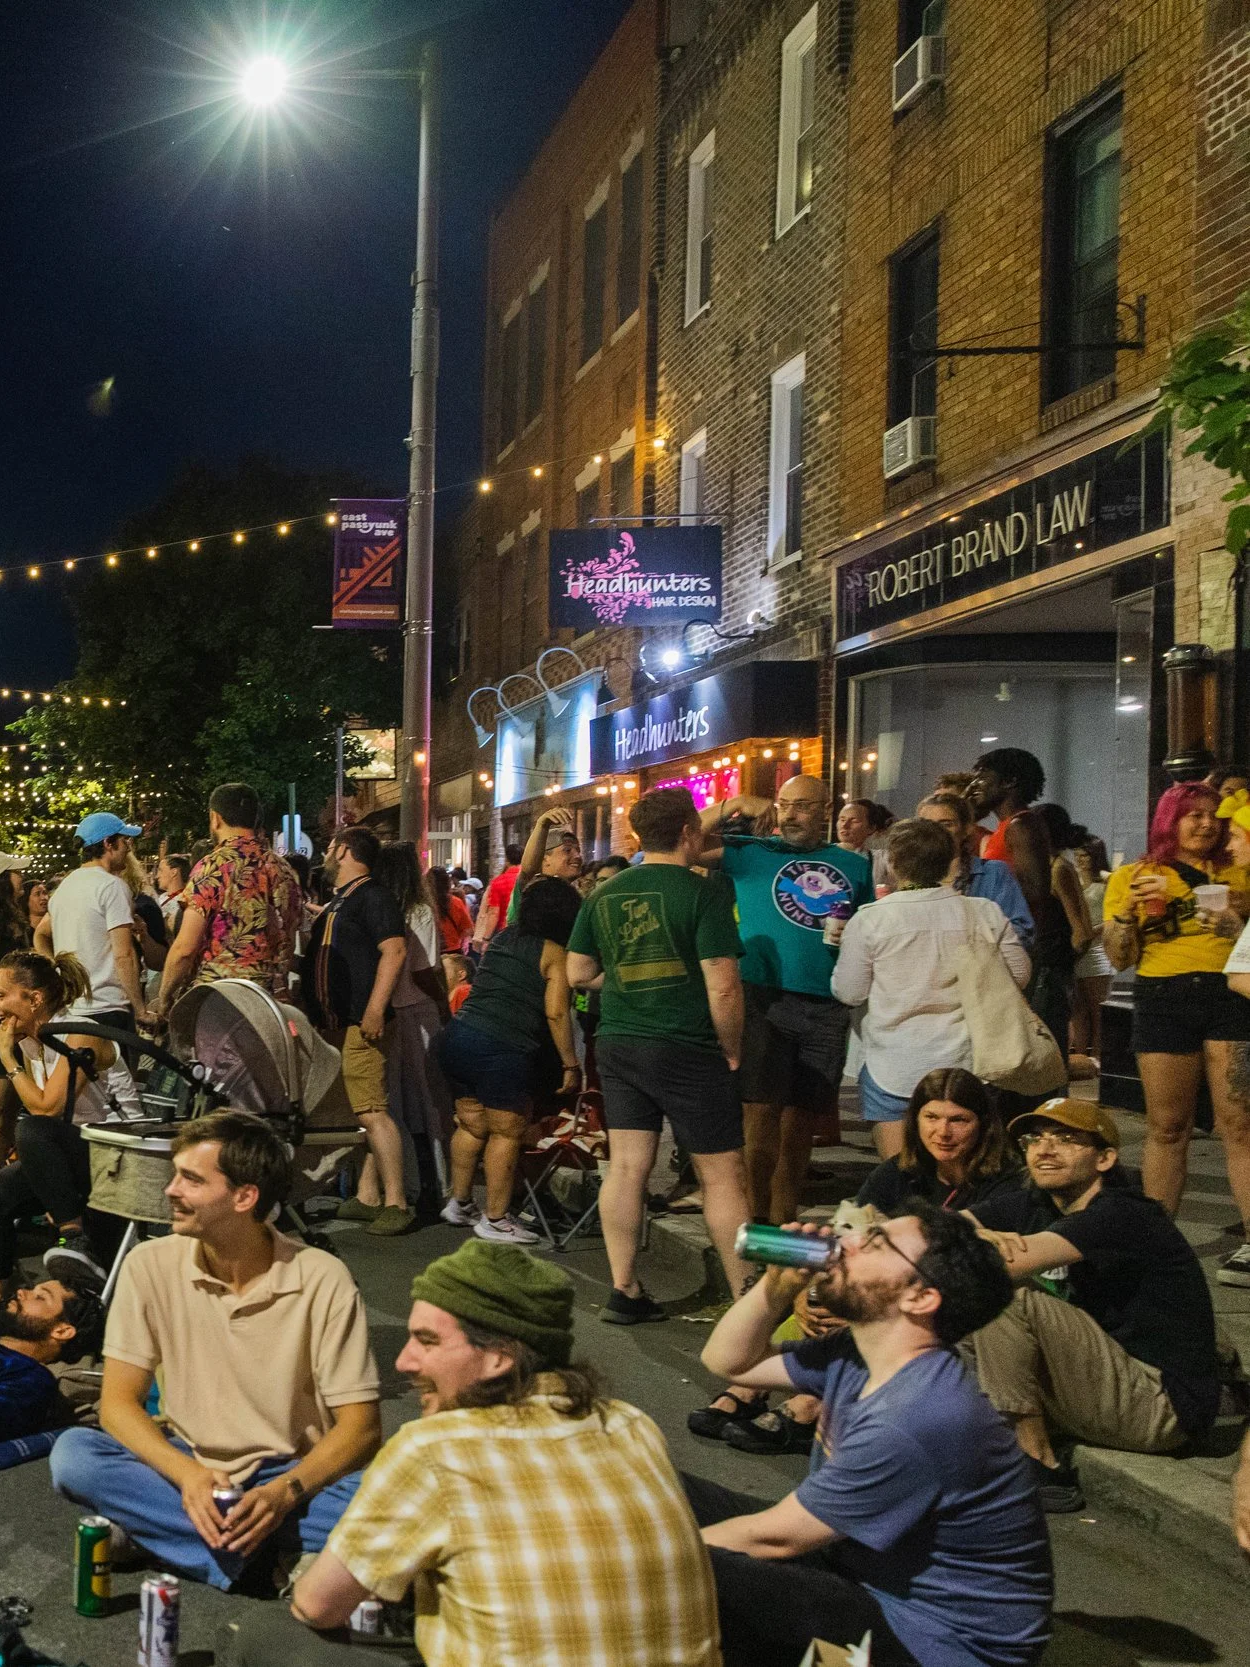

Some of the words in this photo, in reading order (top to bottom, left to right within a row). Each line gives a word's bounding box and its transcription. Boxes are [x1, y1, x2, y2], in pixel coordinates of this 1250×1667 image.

[341, 513, 367, 521] east
[341, 520, 398, 533] passyunk
[869, 543, 945, 608] ROBERT
[952, 512, 1028, 577] BRAND
[1036, 480, 1091, 546] LAW
[566, 573, 712, 595] Headhunters
[652, 596, 675, 607] HAIR
[679, 595, 717, 607] DESIGN
[614, 705, 710, 760] Headhunters
[778, 892, 814, 926] NUNS
[1045, 1098, 1066, 1110] P
